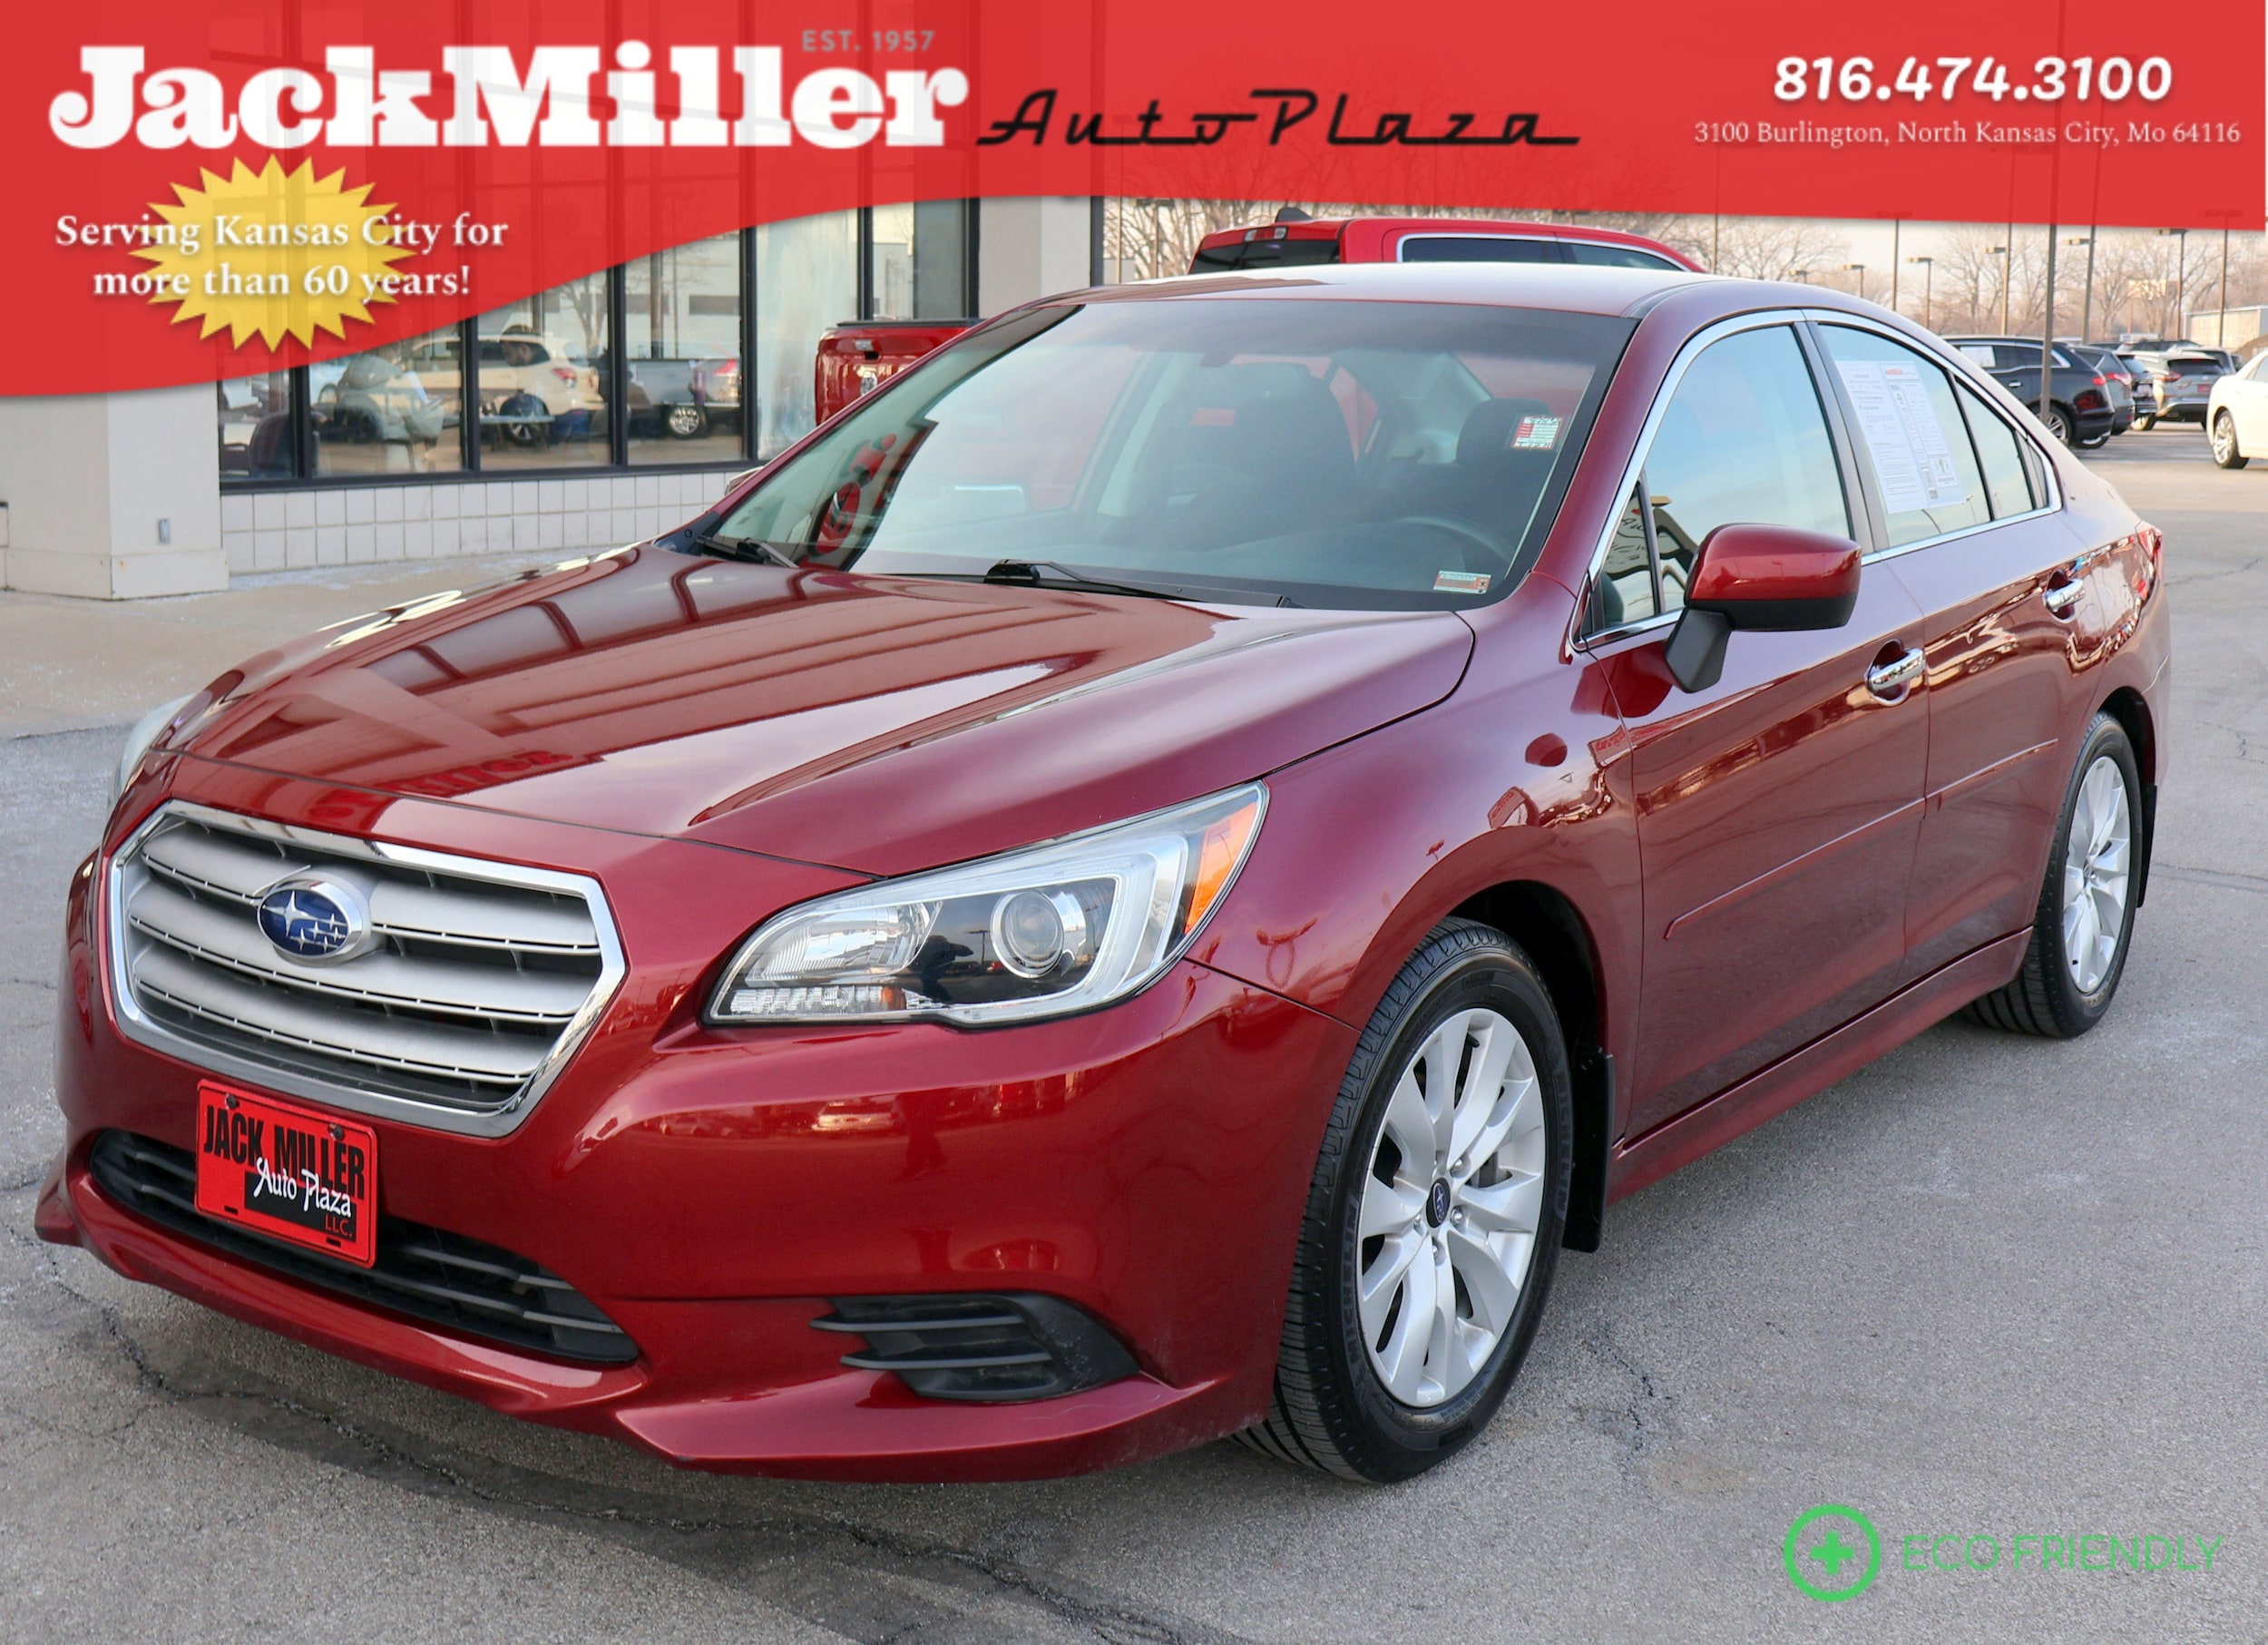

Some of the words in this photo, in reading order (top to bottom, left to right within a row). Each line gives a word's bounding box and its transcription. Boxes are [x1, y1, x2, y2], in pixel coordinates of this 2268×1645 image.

[204, 1104, 264, 1168] JACK
[274, 1124, 365, 1200] MILLER
[253, 1156, 298, 1200] Auto
[300, 1168, 352, 1219] Plaza
[324, 1213, 353, 1238] LLC.
[1343, 1202, 1360, 1365] MICHELIN
